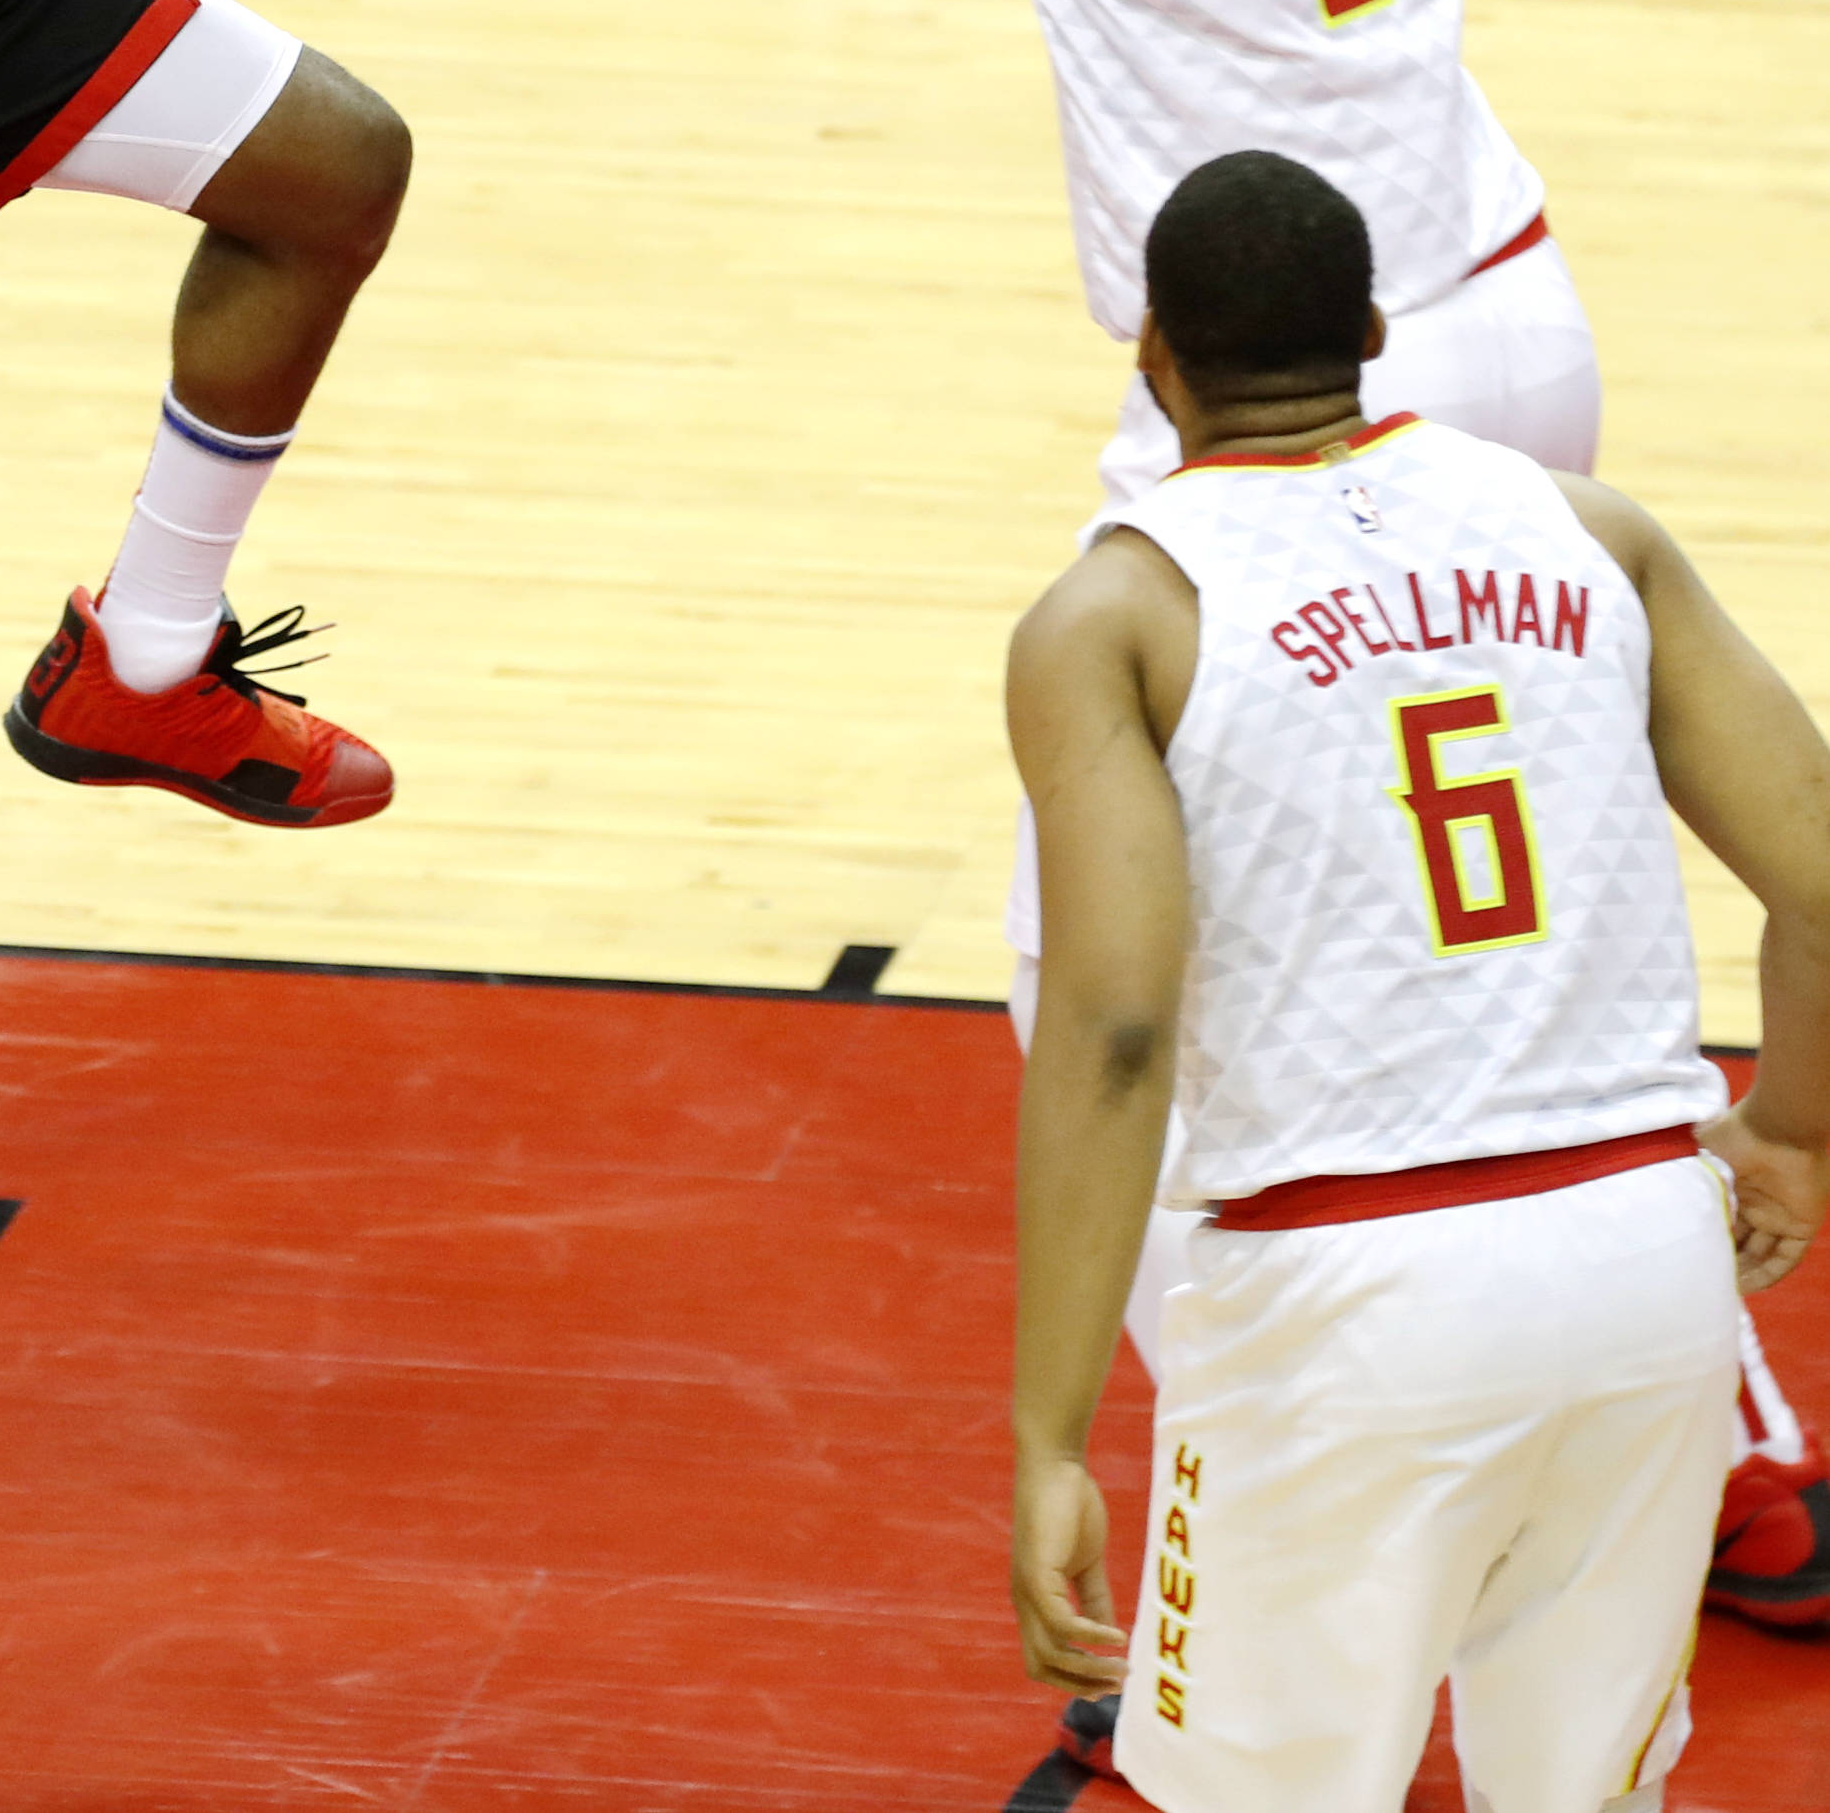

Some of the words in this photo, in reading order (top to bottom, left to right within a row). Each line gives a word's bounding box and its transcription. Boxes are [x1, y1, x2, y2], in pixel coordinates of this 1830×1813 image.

[1272, 568, 1589, 687] SPELLMAN
[1383, 683, 1548, 958] 6
[1156, 1441, 1202, 1731] HAWKS
